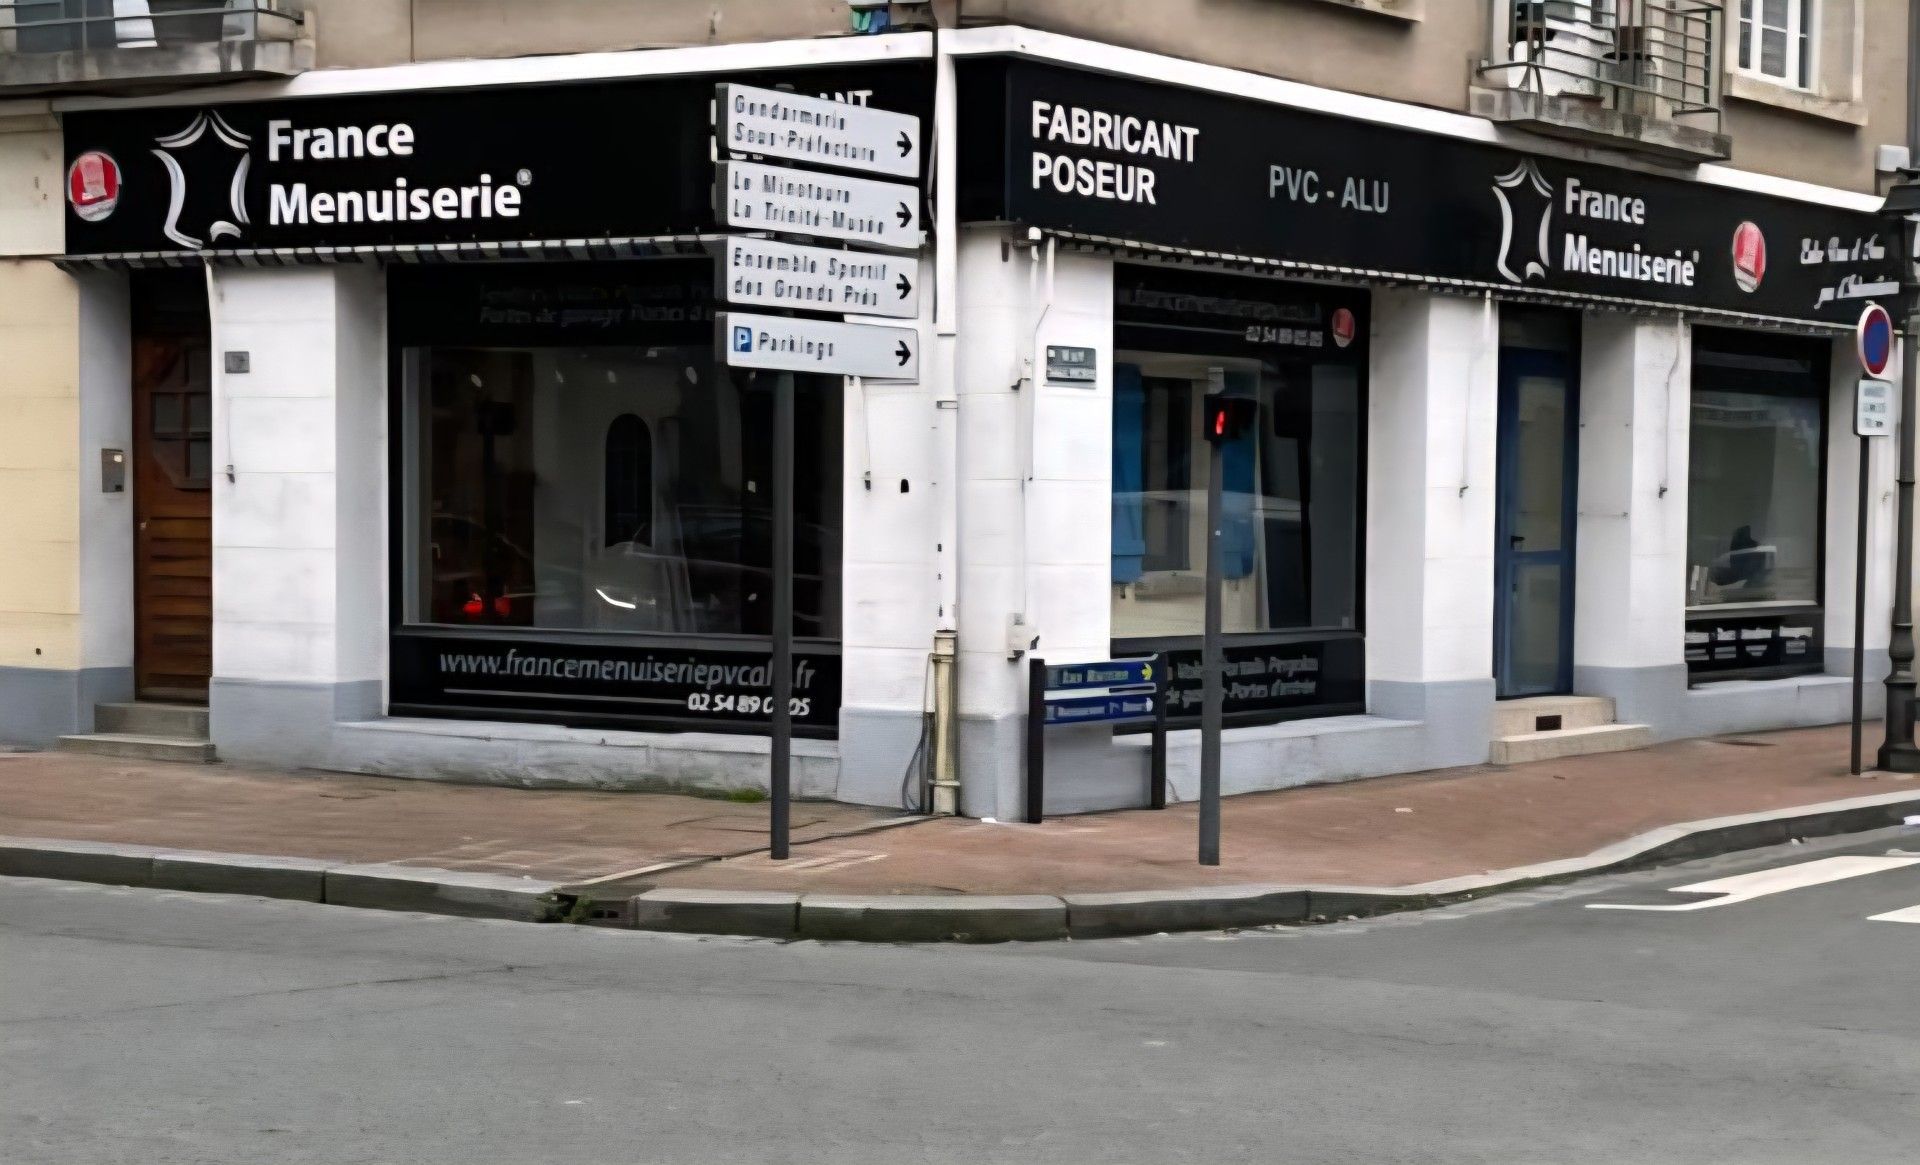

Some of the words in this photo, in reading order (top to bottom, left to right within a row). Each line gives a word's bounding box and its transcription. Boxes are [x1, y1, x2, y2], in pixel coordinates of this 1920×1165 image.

[268, 119, 415, 162] France
[1032, 100, 1199, 162] FABRICANT
[269, 174, 521, 226] Menuiserie
[1032, 152, 1156, 205] POSEUR
[1269, 165, 1319, 203] PVC
[1341, 177, 1389, 213] ALU
[1565, 178, 1645, 225] France
